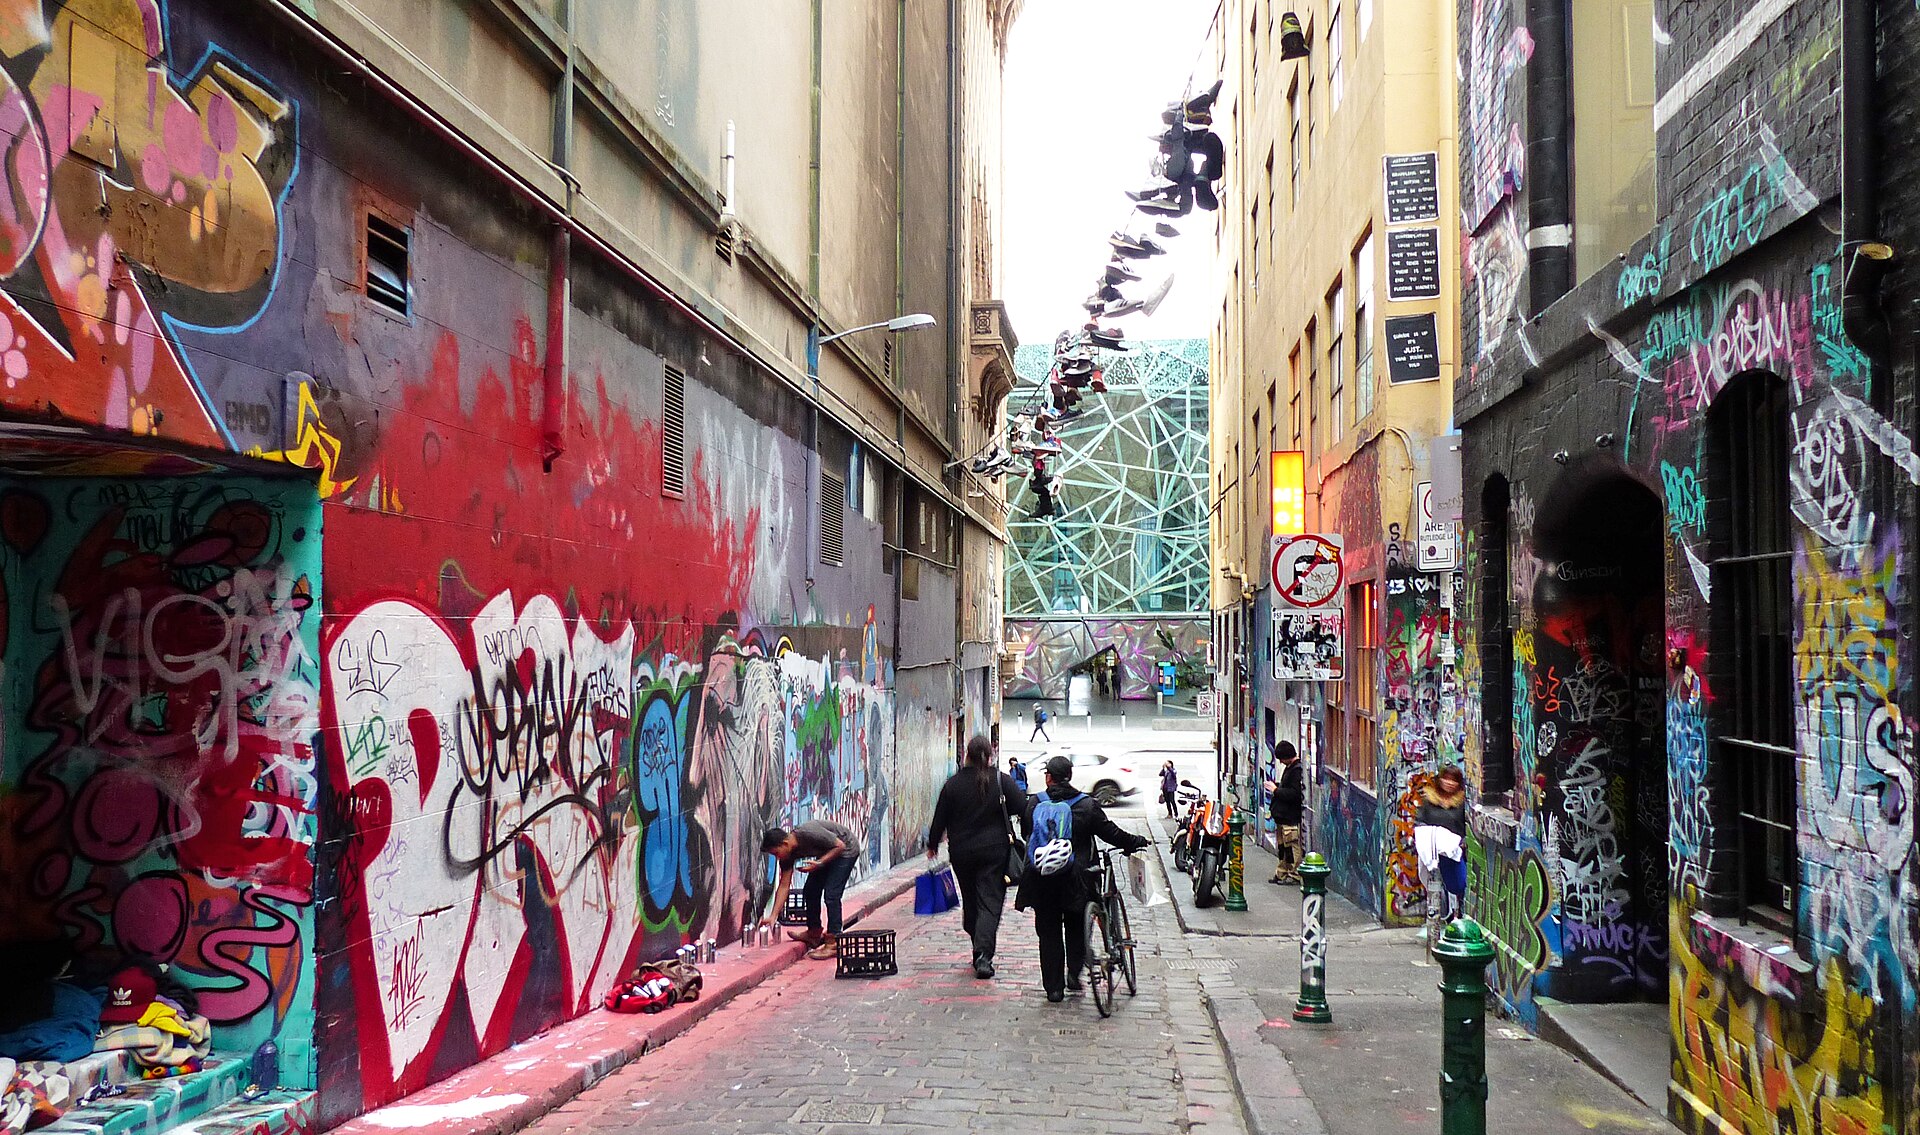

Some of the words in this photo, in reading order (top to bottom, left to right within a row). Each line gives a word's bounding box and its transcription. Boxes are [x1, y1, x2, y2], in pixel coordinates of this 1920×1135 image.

[1425, 522, 1453, 532] ARE
[1420, 534, 1446, 542] RUTLEDGE
[1294, 615, 1304, 623] 30
